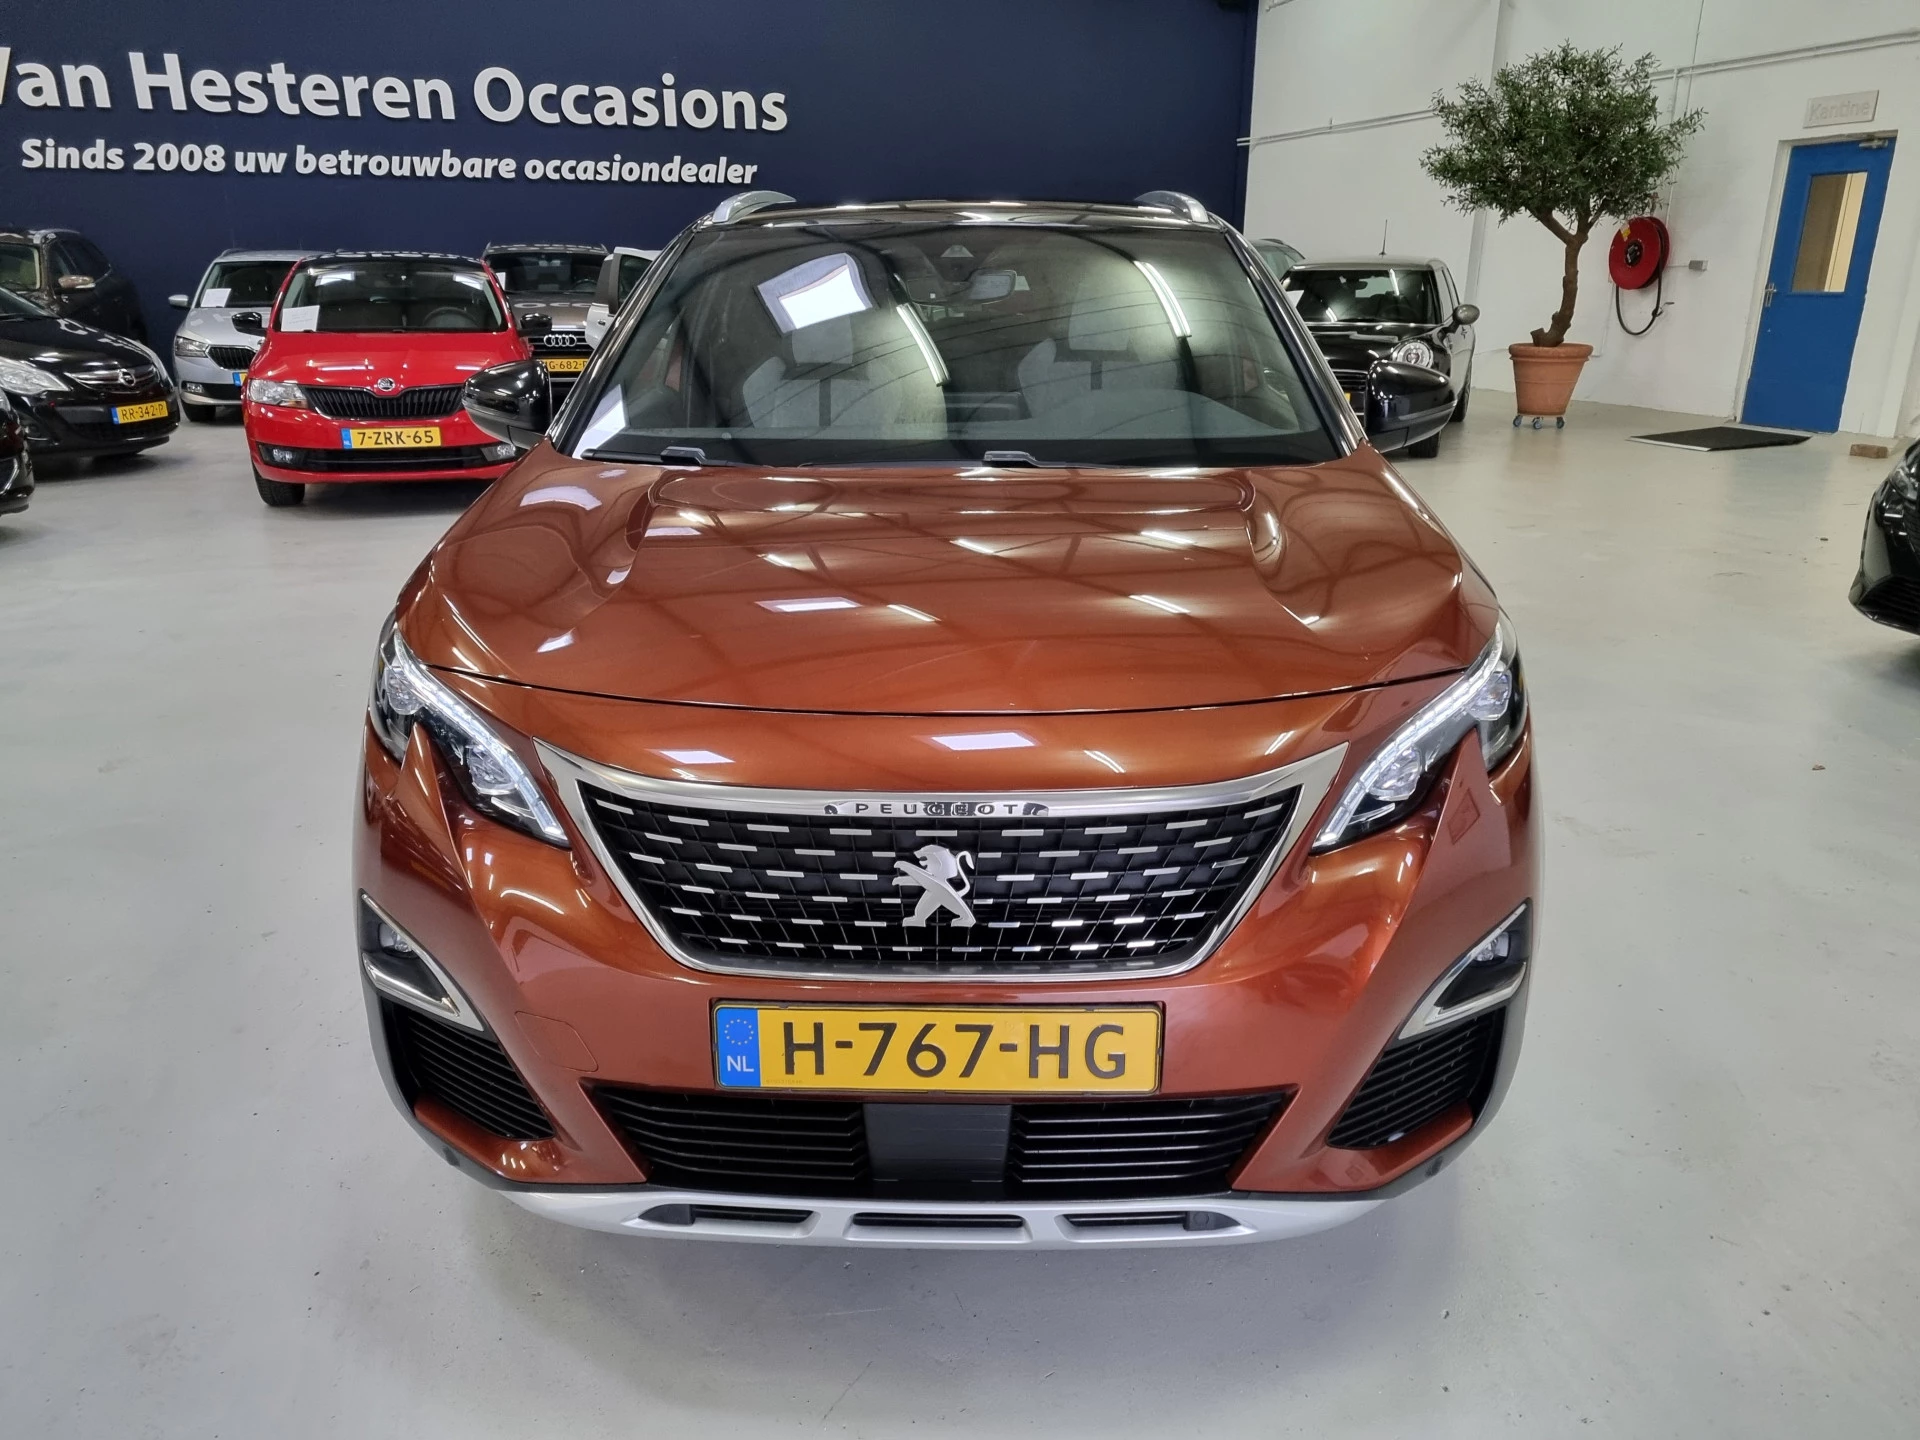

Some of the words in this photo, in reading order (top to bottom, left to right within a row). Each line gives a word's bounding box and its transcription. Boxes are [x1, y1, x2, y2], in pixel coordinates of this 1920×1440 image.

[0, 47, 112, 108] an
[128, 52, 456, 120] Hesteren
[473, 67, 788, 131] Occasions
[1808, 100, 1871, 122] Kantine
[21, 138, 125, 170] Sinds
[132, 142, 226, 173] 2008
[234, 151, 287, 174] uw
[296, 144, 517, 179] betrouwbare
[524, 153, 758, 184] occasiondealer
[120, 403, 164, 421] RR-342-P
[356, 430, 434, 446] 7-ZRK-65
[855, 802, 1018, 816] PEUGEOT
[783, 1021, 1127, 1080] H-767-HG
[726, 1055, 755, 1073] NL
